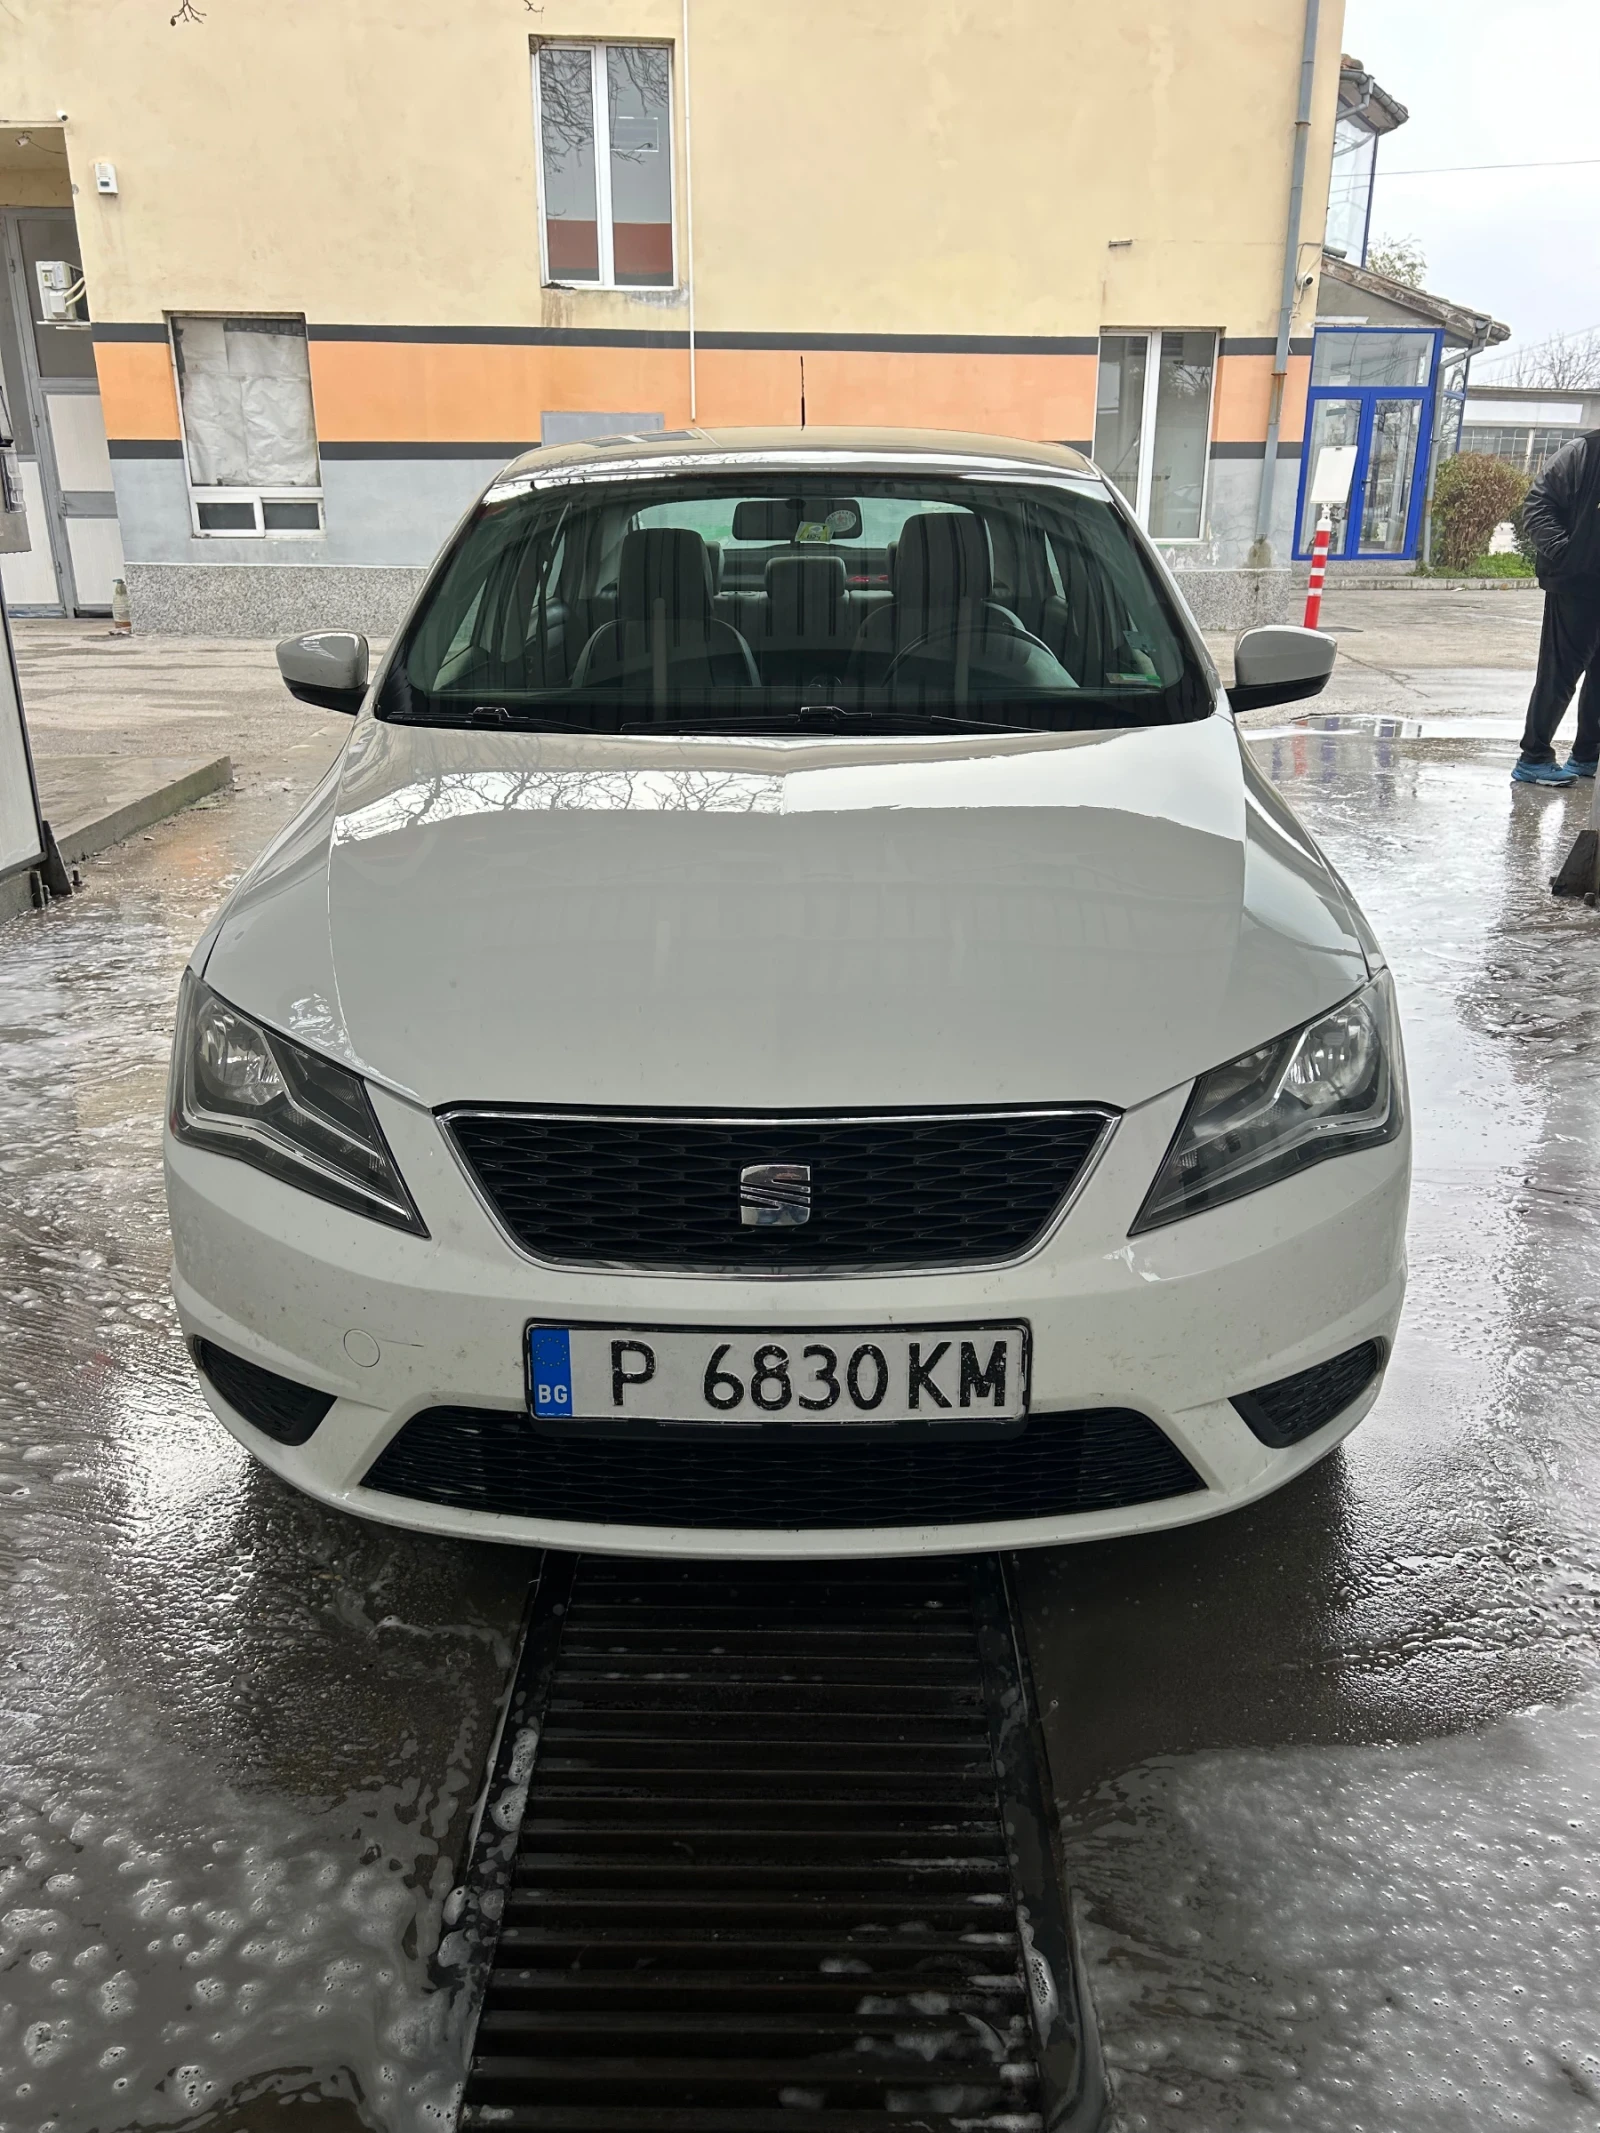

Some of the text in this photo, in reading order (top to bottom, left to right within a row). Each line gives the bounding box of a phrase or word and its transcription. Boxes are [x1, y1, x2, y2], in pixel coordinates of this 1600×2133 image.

[538, 1384, 568, 1404] BG
[611, 1340, 1007, 1411] P 6830 KM
